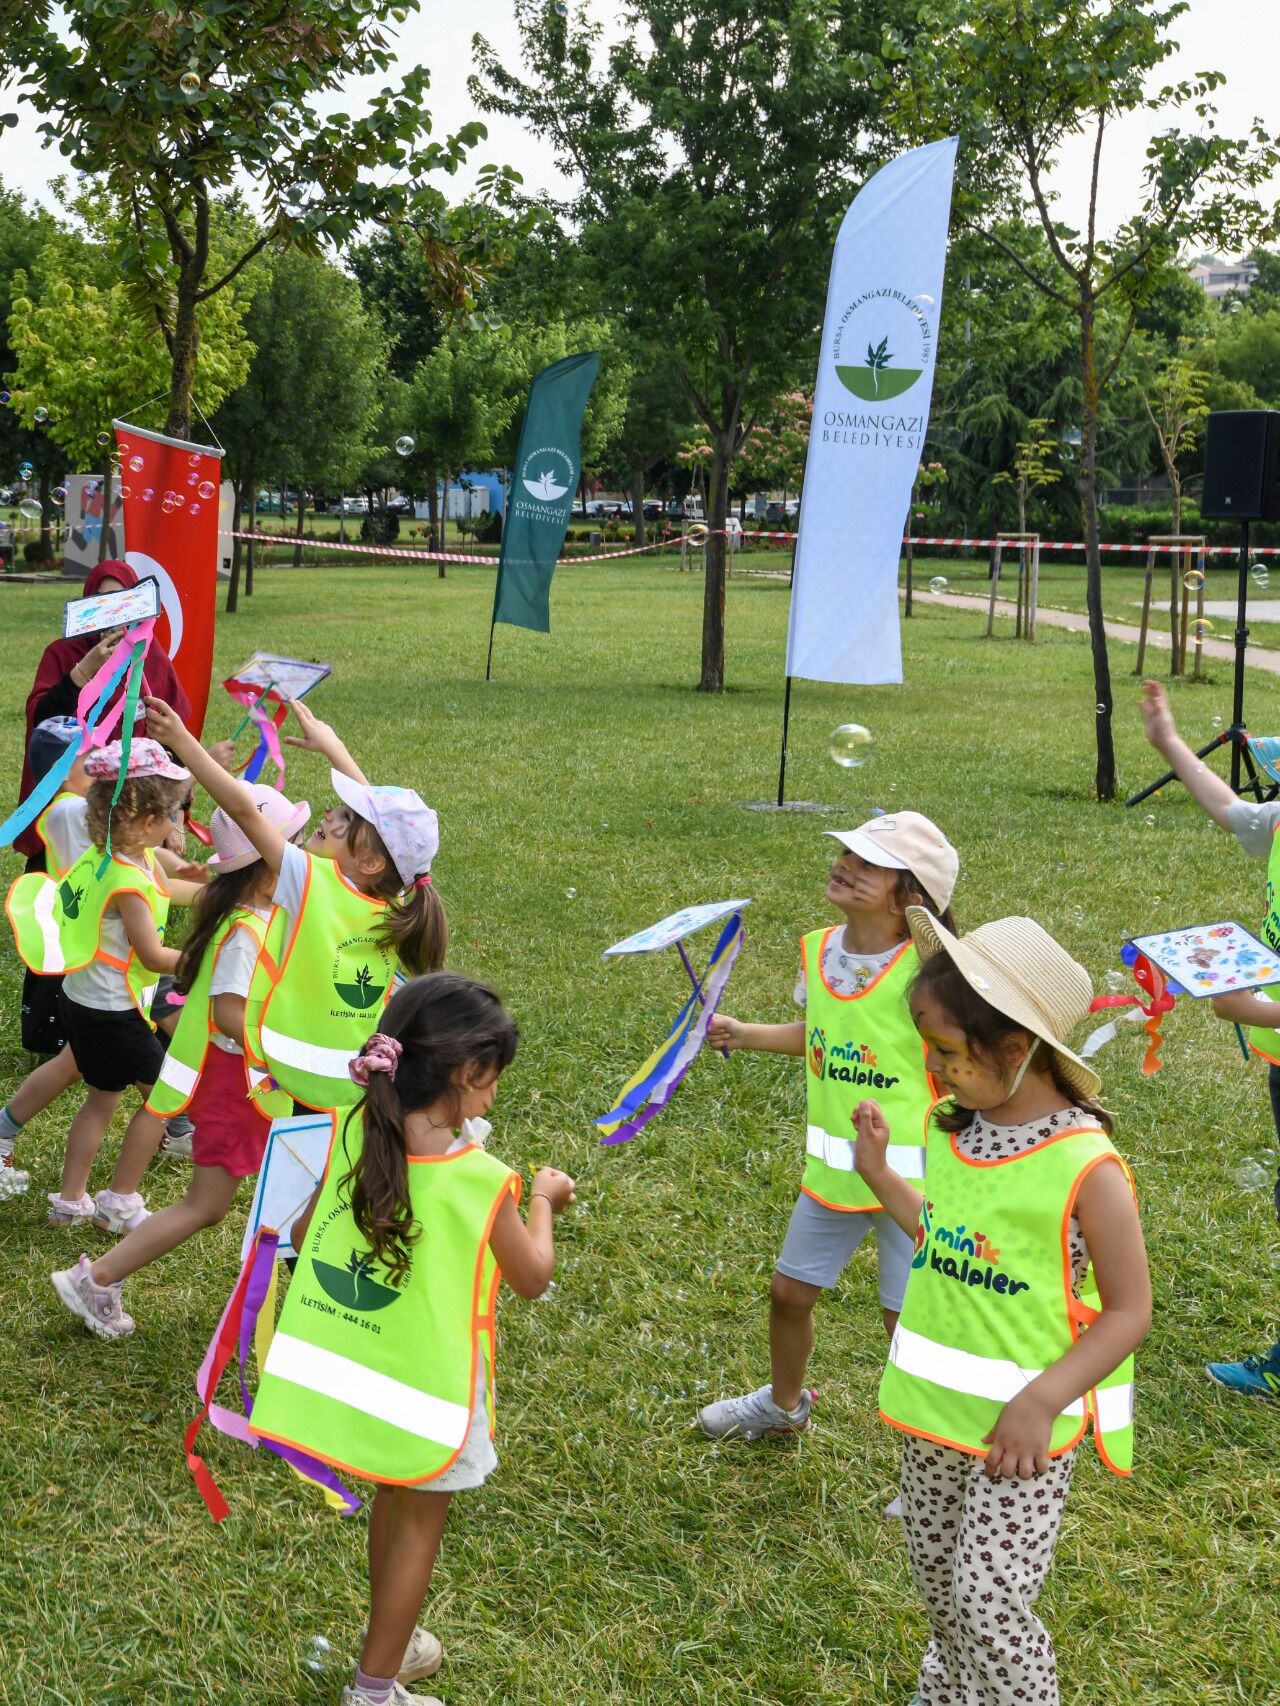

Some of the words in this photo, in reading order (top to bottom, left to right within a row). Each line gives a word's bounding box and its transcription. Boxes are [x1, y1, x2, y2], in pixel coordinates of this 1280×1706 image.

[833, 325, 845, 360] BURSA
[841, 288, 892, 323] OSMANGAZİ
[921, 343, 931, 364] 1987
[824, 411, 924, 433] OSMANGAZİ
[822, 430, 921, 449] BELEDİYESİ
[830, 1041, 878, 1068] minik
[828, 1062, 900, 1089] kalpler
[311, 1221, 330, 1253] BURSA
[935, 1225, 1001, 1265] minik
[930, 1248, 1030, 1296] kalpler
[342, 1312, 359, 1324] 444
[360, 1319, 371, 1330] 16
